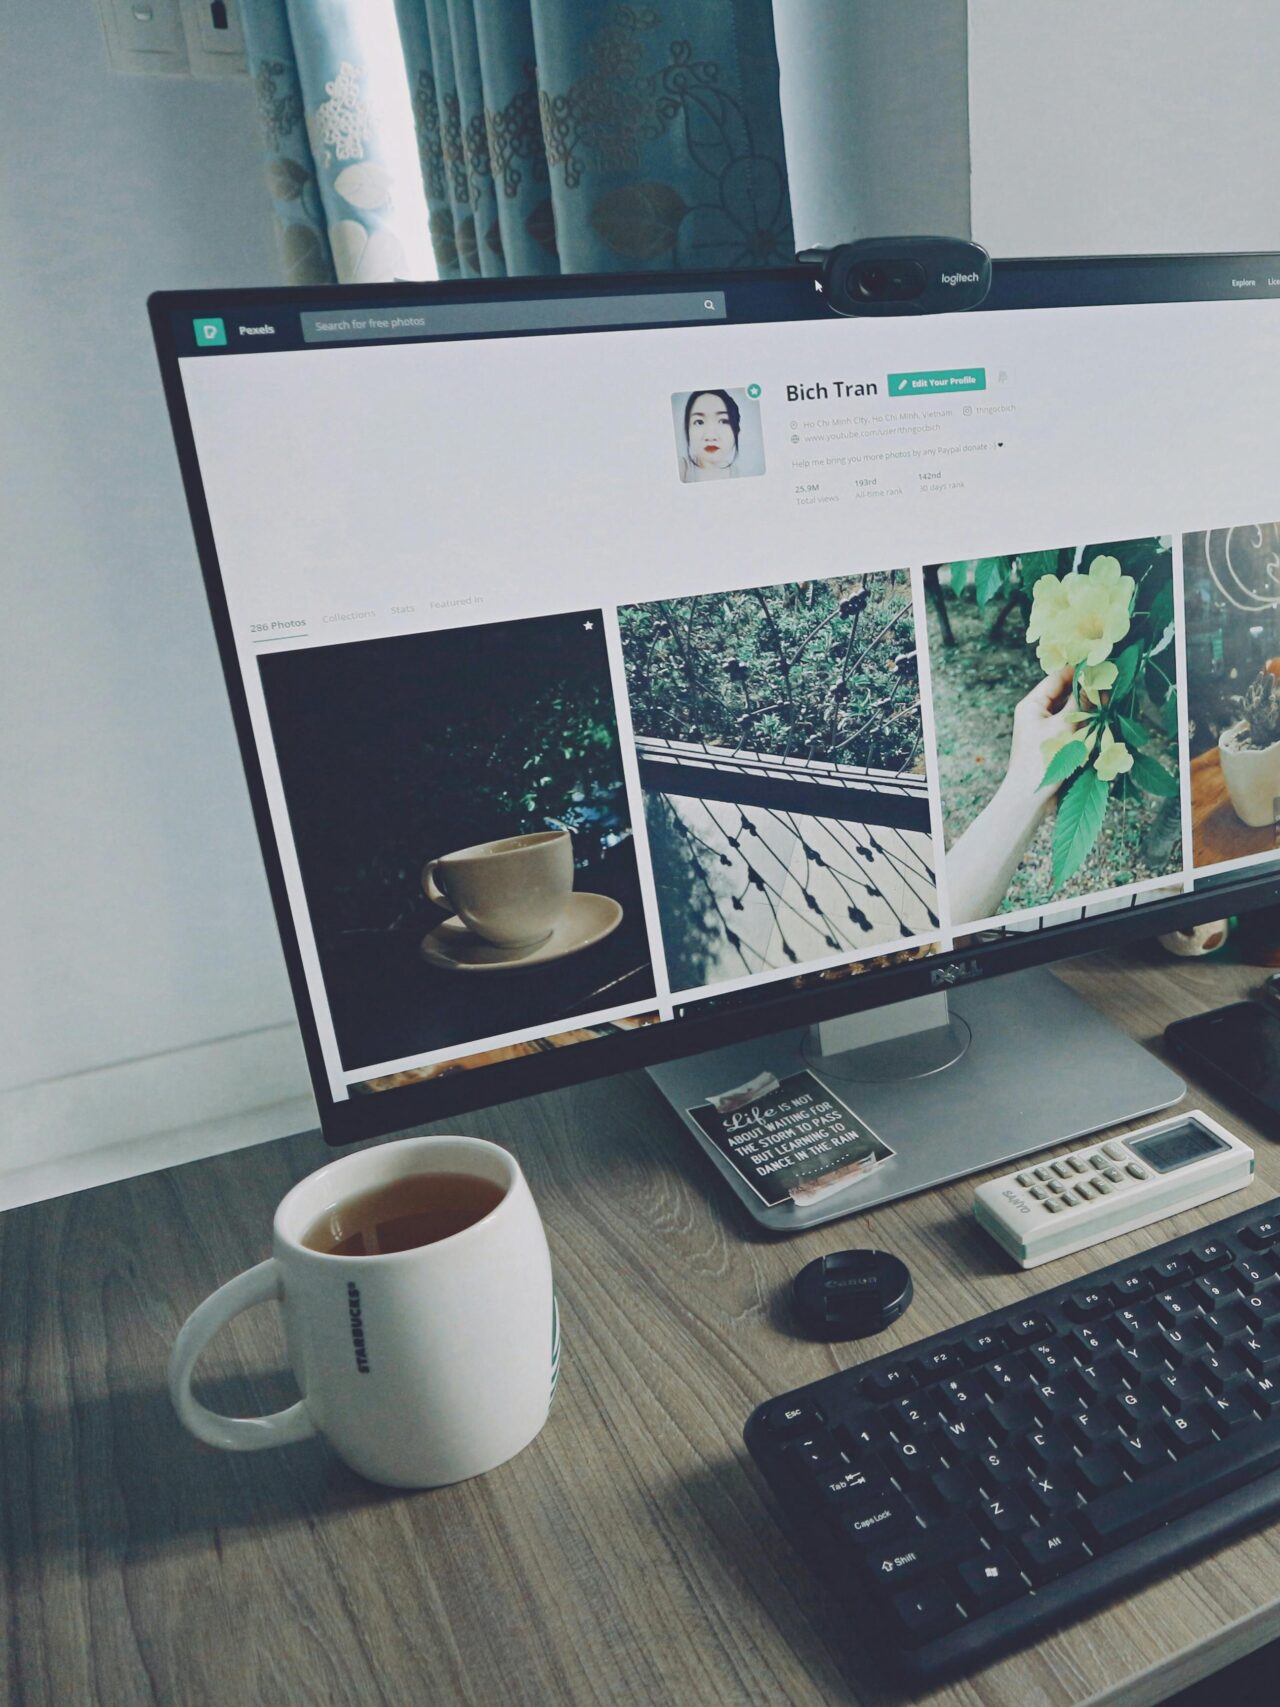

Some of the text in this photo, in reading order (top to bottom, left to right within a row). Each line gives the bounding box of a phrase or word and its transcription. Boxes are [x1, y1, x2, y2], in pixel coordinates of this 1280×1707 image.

[941, 271, 979, 286] logitech
[1232, 278, 1256, 288] Explore
[239, 324, 275, 336] Pexels
[315, 316, 426, 332] Search for free photos
[929, 377, 948, 386] Your
[950, 376, 976, 385] Profile
[787, 381, 878, 402] Bich Tran
[832, 417, 852, 426] Minh
[792, 460, 810, 469] Help
[826, 457, 846, 466] bring
[885, 449, 911, 460] photos
[938, 445, 961, 455] Paypal
[963, 443, 987, 452] donate
[855, 478, 877, 487] 193rd
[918, 471, 942, 480] 142nd
[796, 497, 815, 505] Total
[391, 605, 415, 615] Stats
[430, 597, 472, 609] Featured
[322, 609, 376, 624] Collections
[250, 618, 307, 633] 286 Photos
[722, 1106, 778, 1132] Life
[791, 1093, 814, 1108] NOT
[728, 1101, 833, 1147] ABOUT WAITING FOR
[734, 1110, 843, 1157] THE STORM TO PASS
[750, 1122, 846, 1166] BUT LEARNING TO
[756, 1130, 859, 1177] DANCE IN THE RAIN
[1002, 1190, 1031, 1214] SANYO
[824, 1276, 878, 1289] Canon
[347, 1281, 370, 1374] STARBUCKS
[785, 1408, 801, 1420] Esc
[829, 1481, 847, 1492] Tab
[854, 1510, 892, 1530] Caps Lock
[1048, 1536, 1064, 1548] Alt
[893, 1553, 917, 1567] Shift
